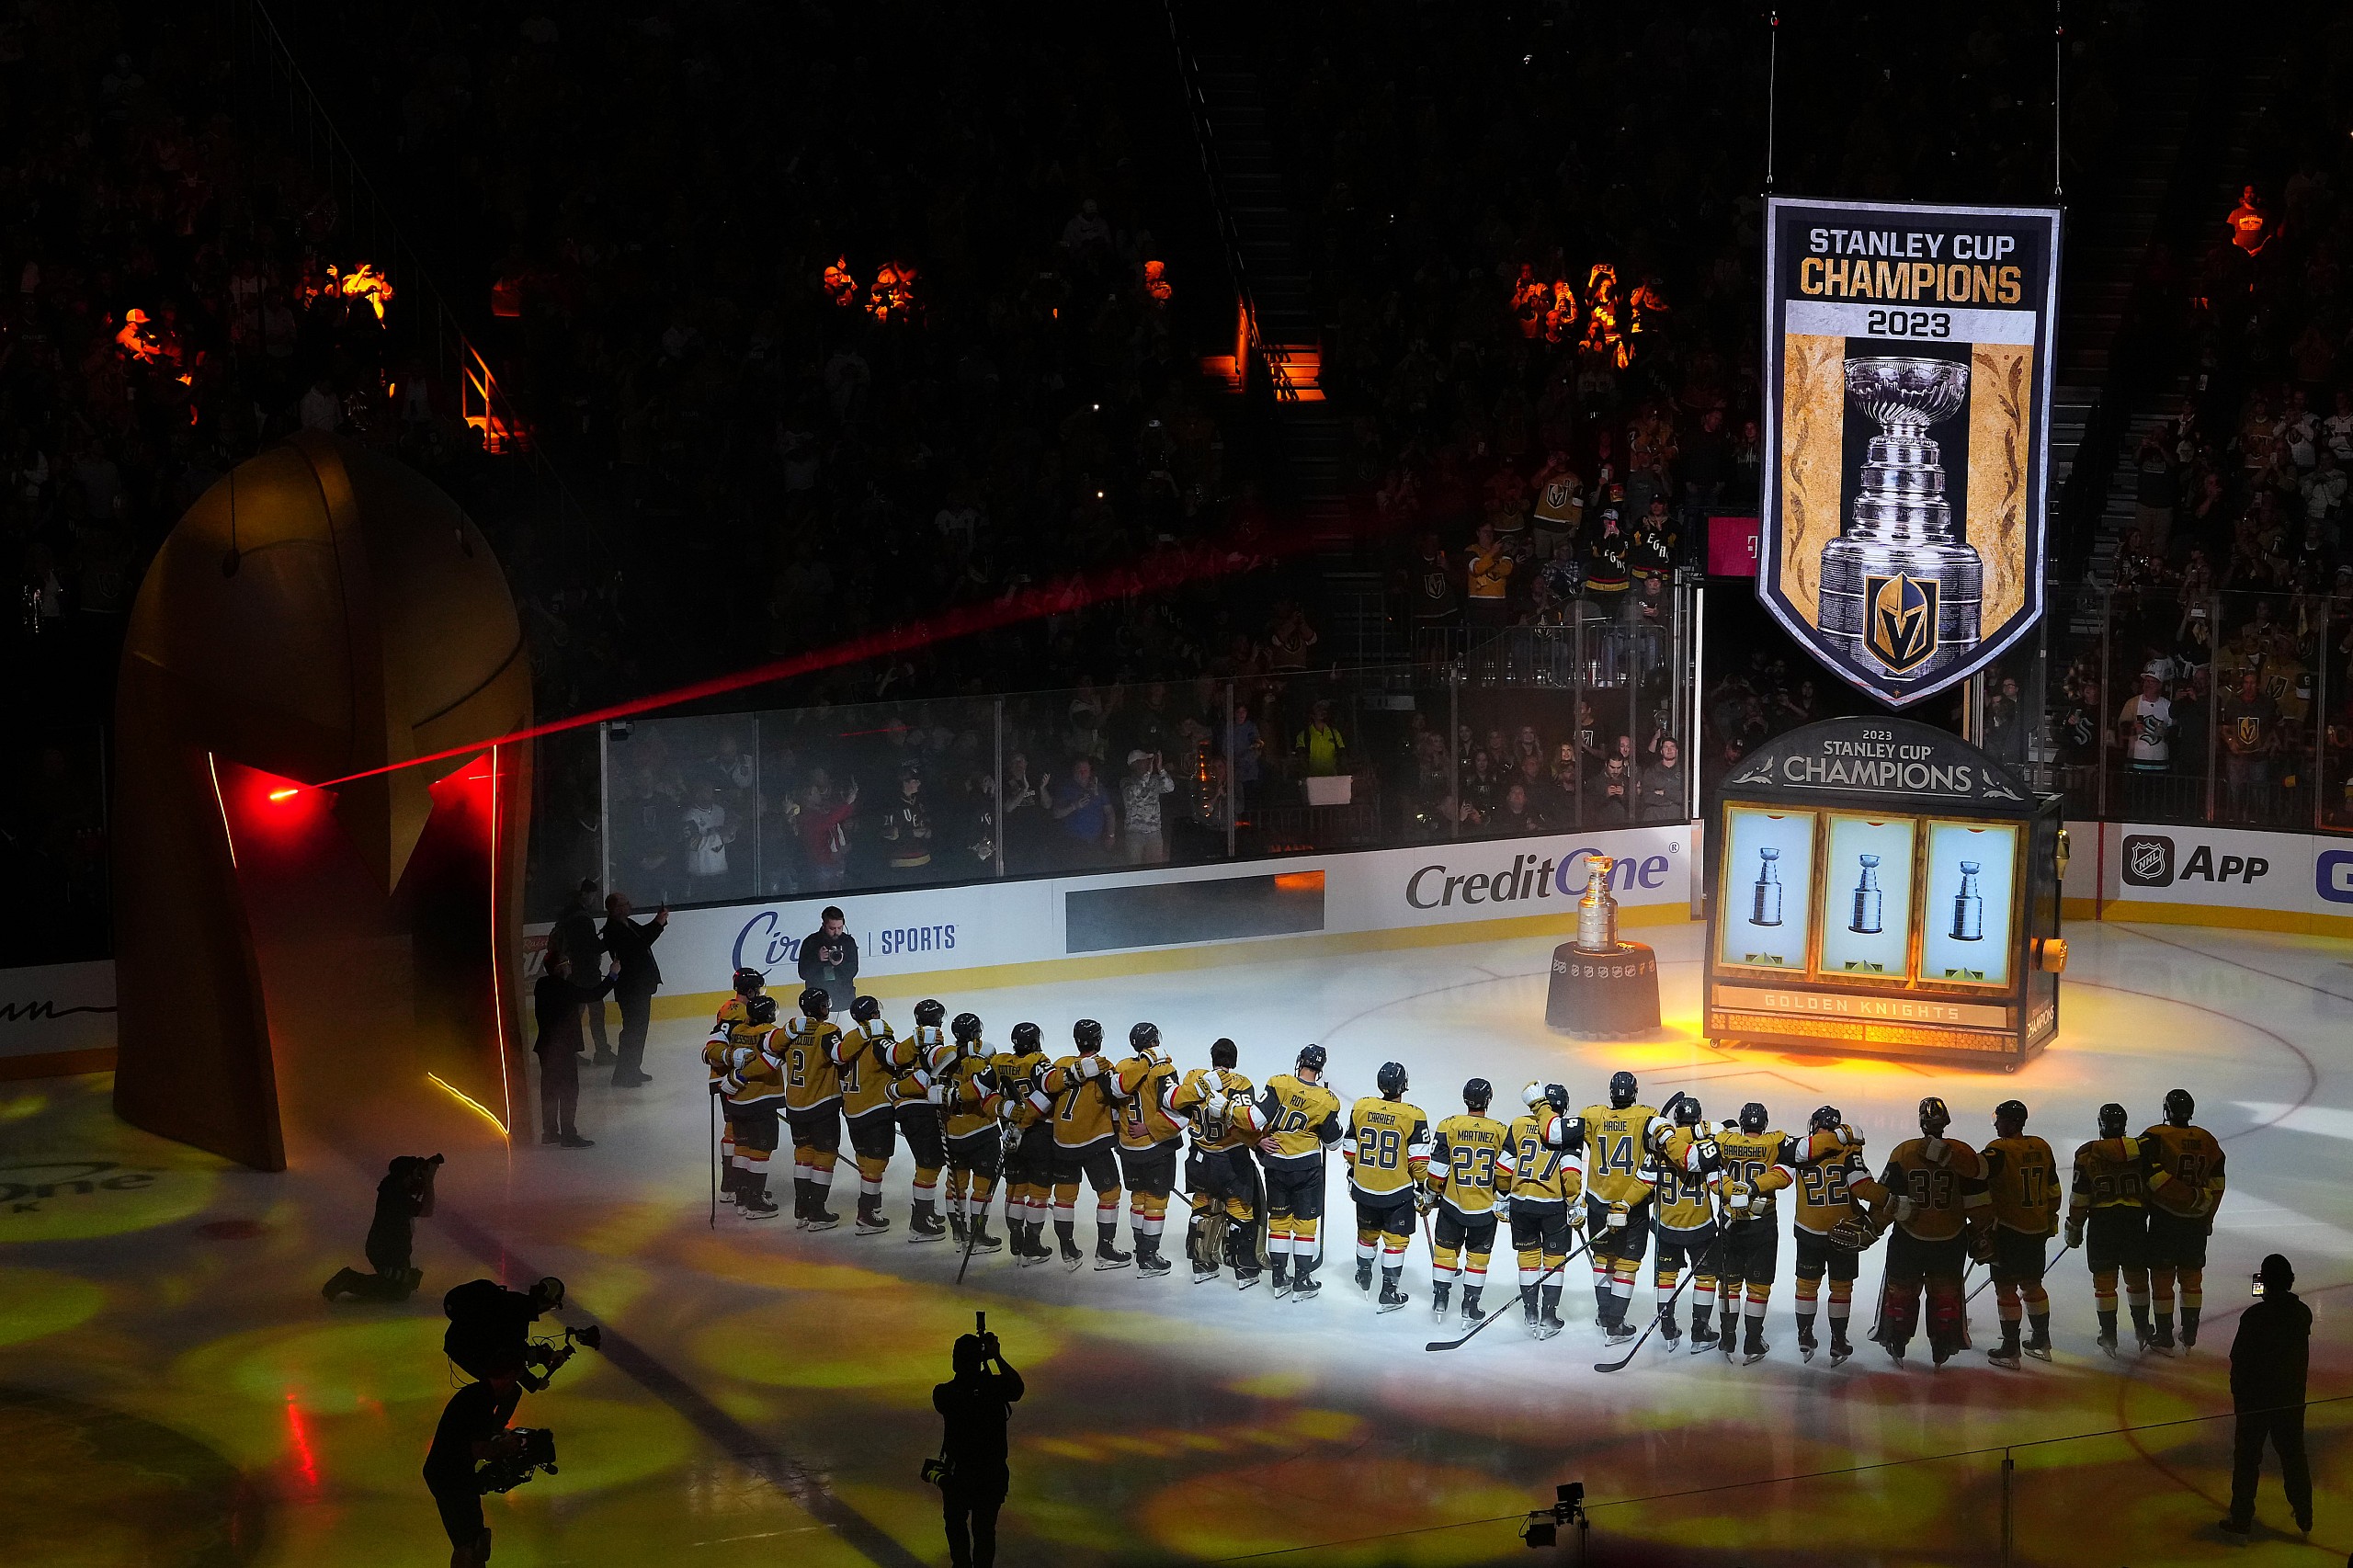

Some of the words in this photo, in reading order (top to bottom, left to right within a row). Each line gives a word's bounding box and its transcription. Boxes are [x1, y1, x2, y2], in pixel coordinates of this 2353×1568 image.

[1810, 228, 1944, 258] STANLEY
[1953, 234, 2015, 261] CUP
[1800, 257, 2021, 304] CHAMPIONS
[1868, 310, 1950, 338] 2023
[1824, 740, 1896, 759] STANLEY
[1899, 745, 1932, 760] CUP
[1862, 730, 1893, 741] 2023
[1783, 756, 1972, 792] CHAMPIONS
[1406, 847, 1669, 910] CreditOne
[2139, 850, 2159, 870] NHL
[733, 911, 800, 977] Cir
[881, 925, 955, 955] SPORTS
[1764, 994, 1848, 1013] GOLDEN
[1860, 1000, 1959, 1020] KNIGHTS
[790, 1049, 805, 1087] 2
[1290, 1095, 1307, 1108] ROY
[1367, 1111, 1395, 1126] CARRIER
[1457, 1130, 1495, 1144] MARTINEZ
[1603, 1120, 1627, 1132] HAGUE
[1359, 1126, 1402, 1170] 28
[1451, 1146, 1495, 1187] 23
[1517, 1138, 1562, 1182] 27
[1597, 1135, 1634, 1176] 14
[1723, 1144, 1768, 1158] BARBASHEV
[1658, 1165, 1705, 1207] 94
[1801, 1164, 1850, 1207] 22
[1908, 1169, 1955, 1211] 33
[2019, 1165, 2044, 1208] 17
